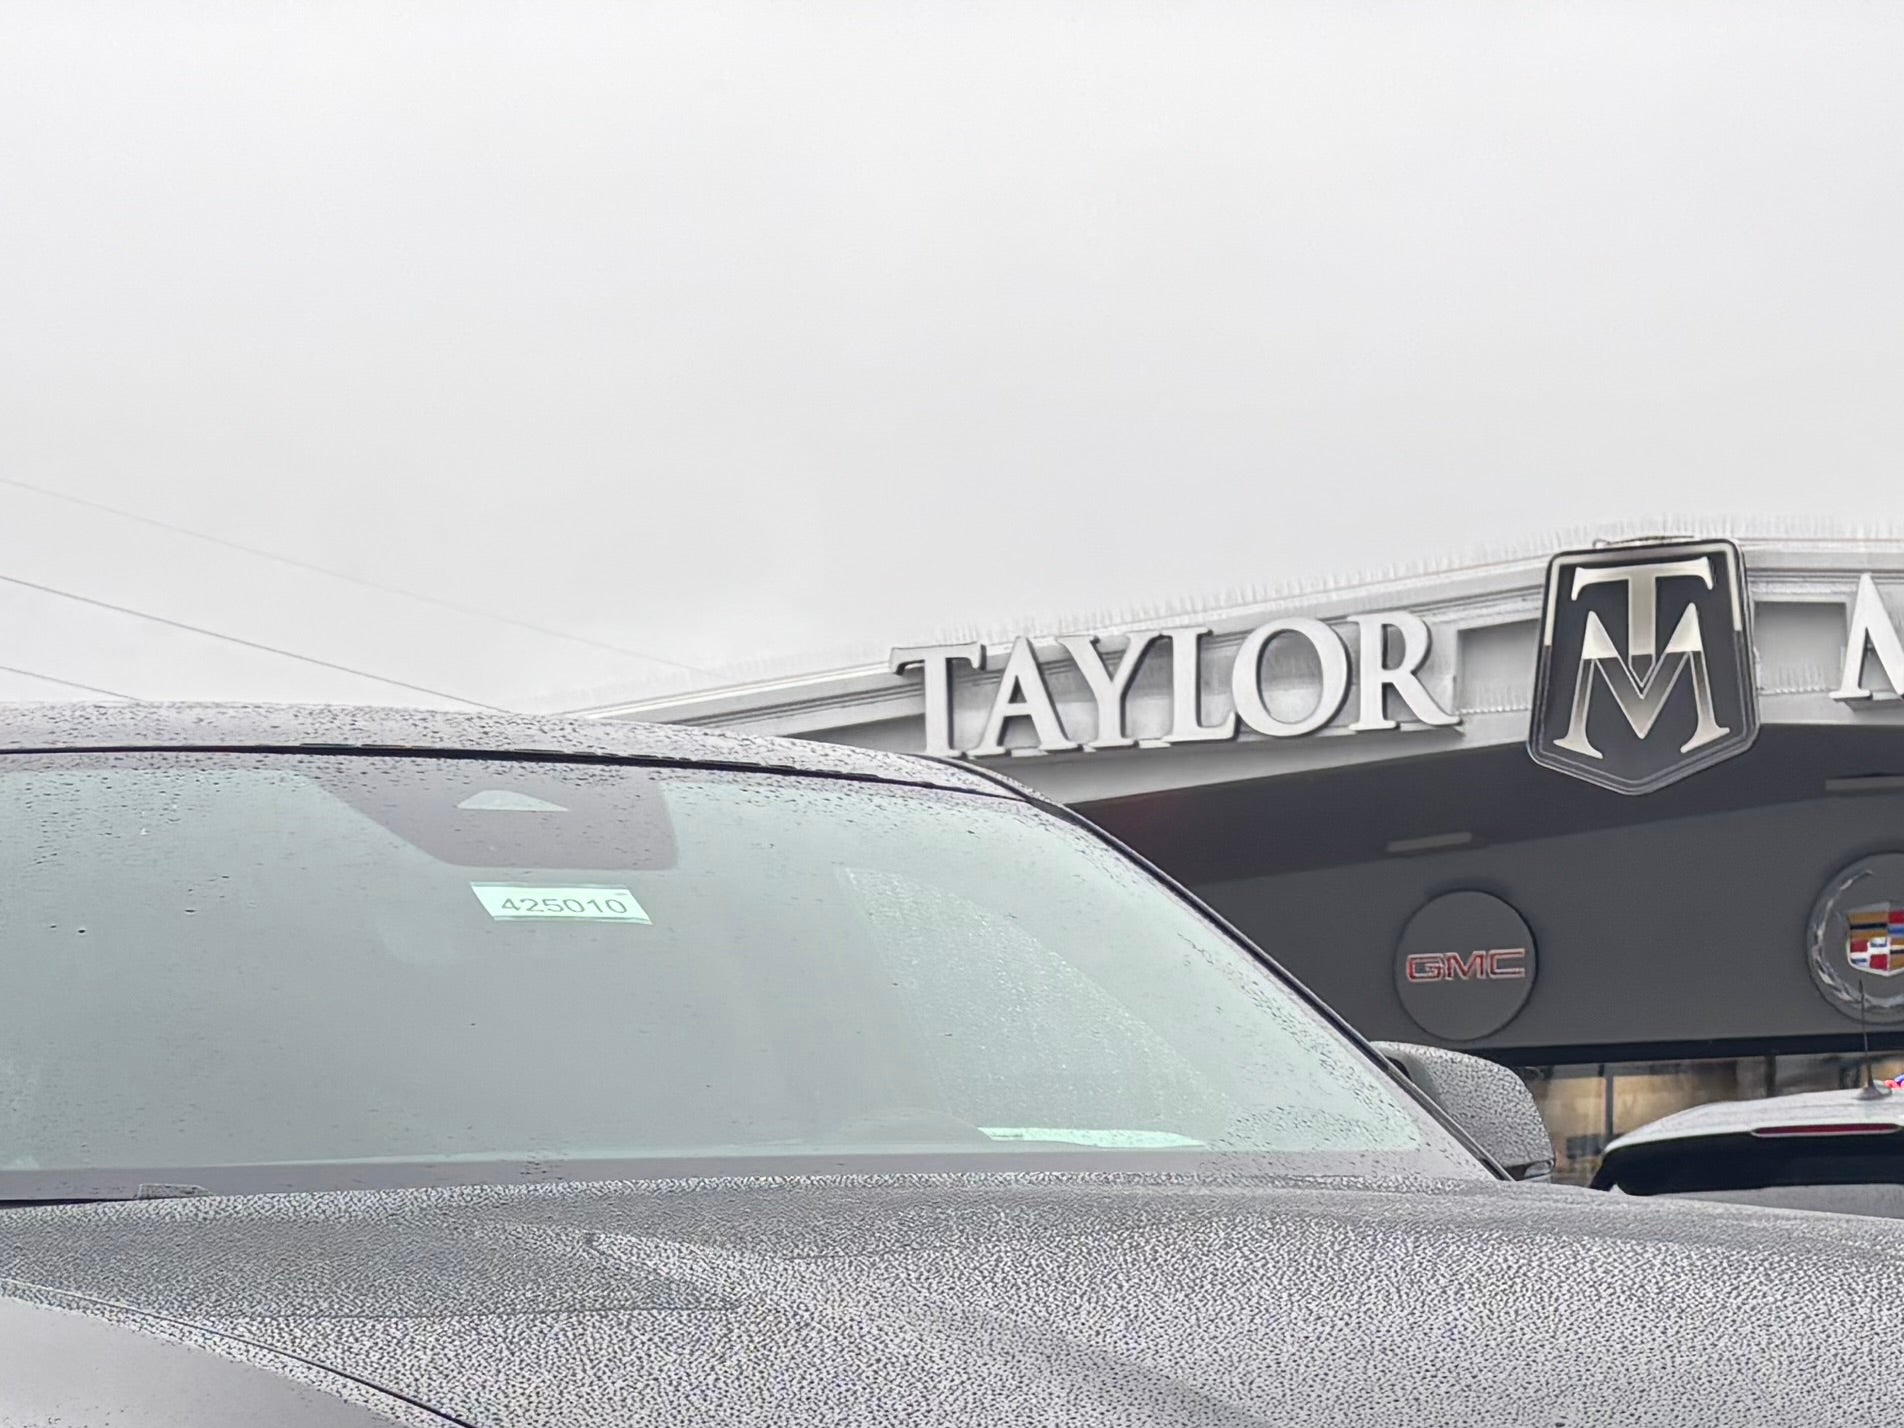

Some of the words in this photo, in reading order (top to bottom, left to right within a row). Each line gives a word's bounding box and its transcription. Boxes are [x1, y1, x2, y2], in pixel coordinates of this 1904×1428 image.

[891, 612, 1463, 758] TAYLOR
[501, 898, 628, 914] 425010
[1406, 948, 1526, 982] GMC
